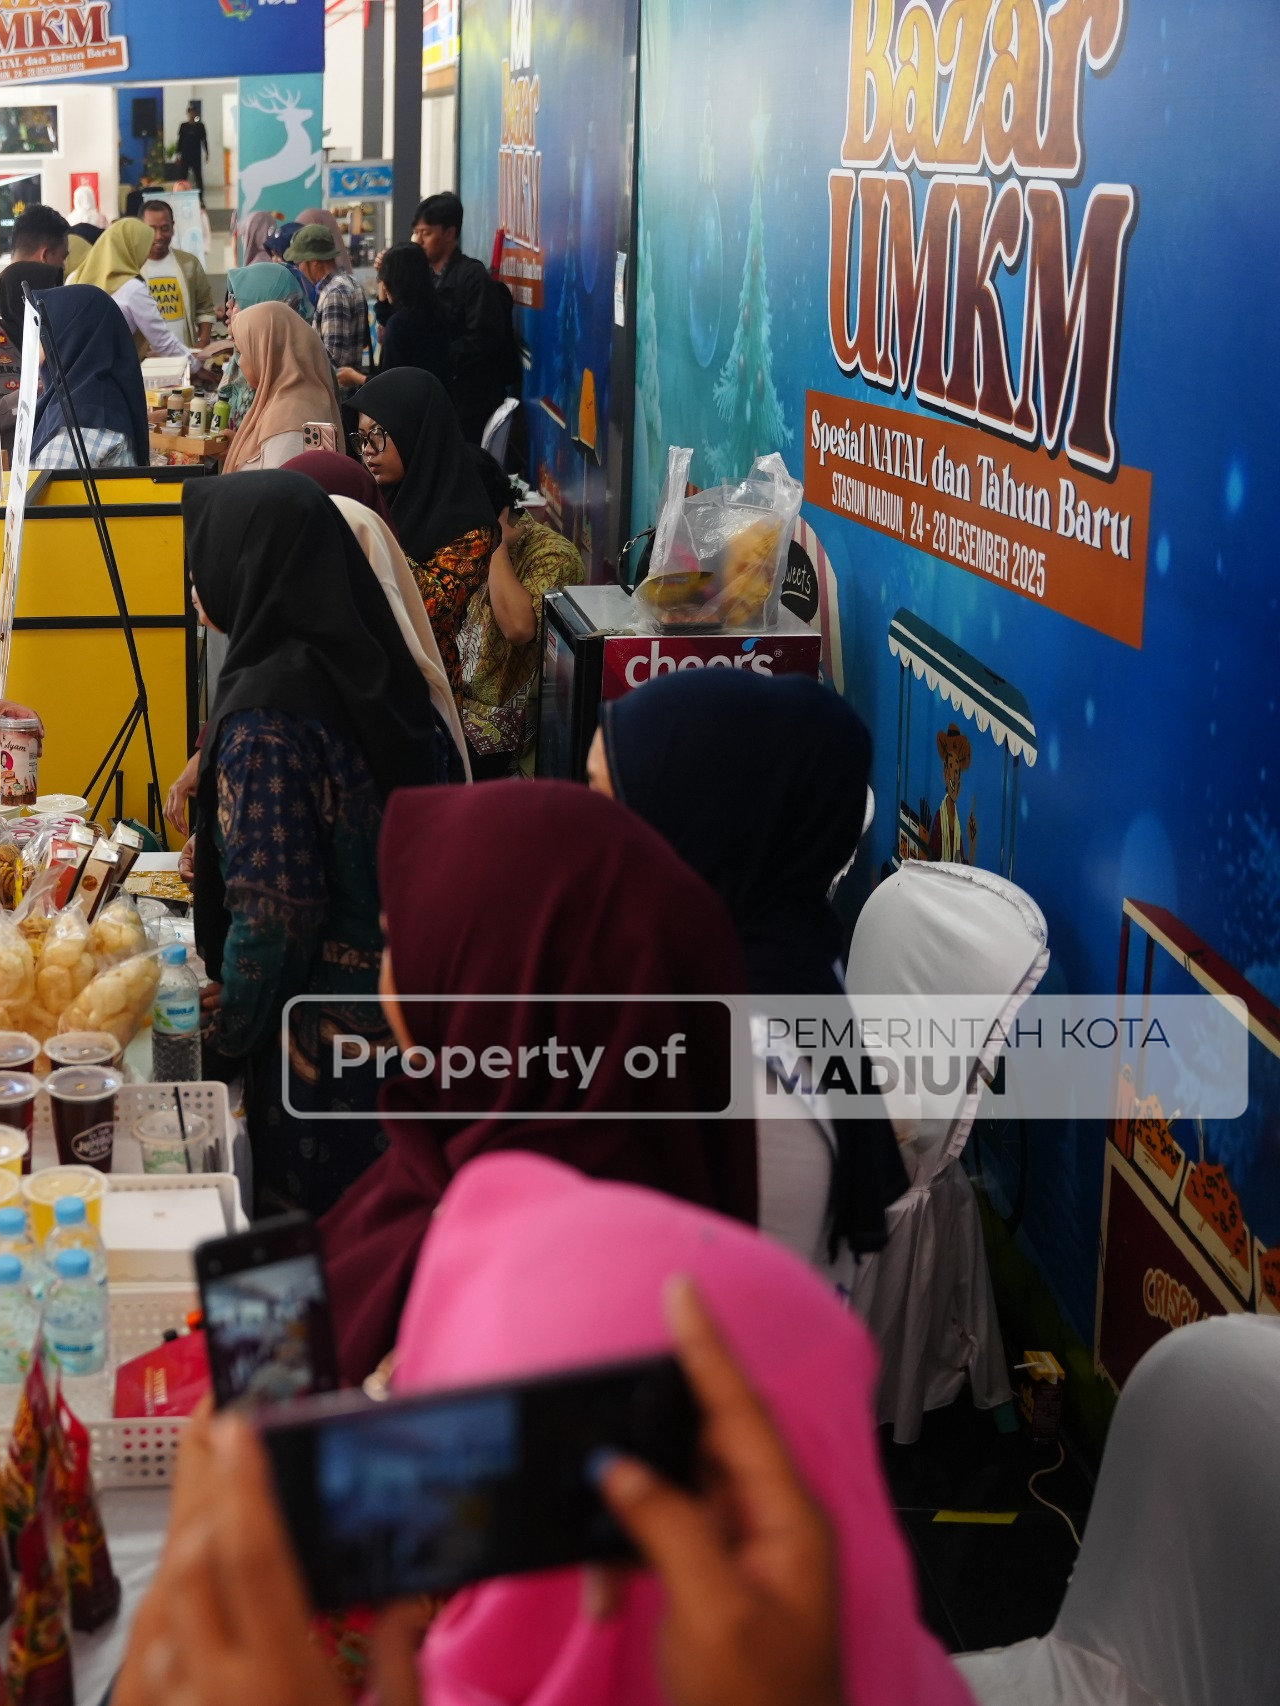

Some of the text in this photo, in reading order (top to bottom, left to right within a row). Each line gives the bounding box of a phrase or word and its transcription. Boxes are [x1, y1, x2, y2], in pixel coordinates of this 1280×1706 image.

[828, 168, 1134, 474] UMKM
[811, 409, 1132, 560] Spesial NATAL dan Tahun Baru
[832, 471, 866, 516] STASIUN
[868, 486, 906, 541] MADIUN,
[910, 500, 925, 543] 24
[933, 510, 947, 554] 28
[948, 515, 1009, 582] DESEMBER
[1012, 543, 1046, 599] 2025
[4, 740, 27, 752] Ayam
[1143, 1268, 1199, 1329] CRISPY
